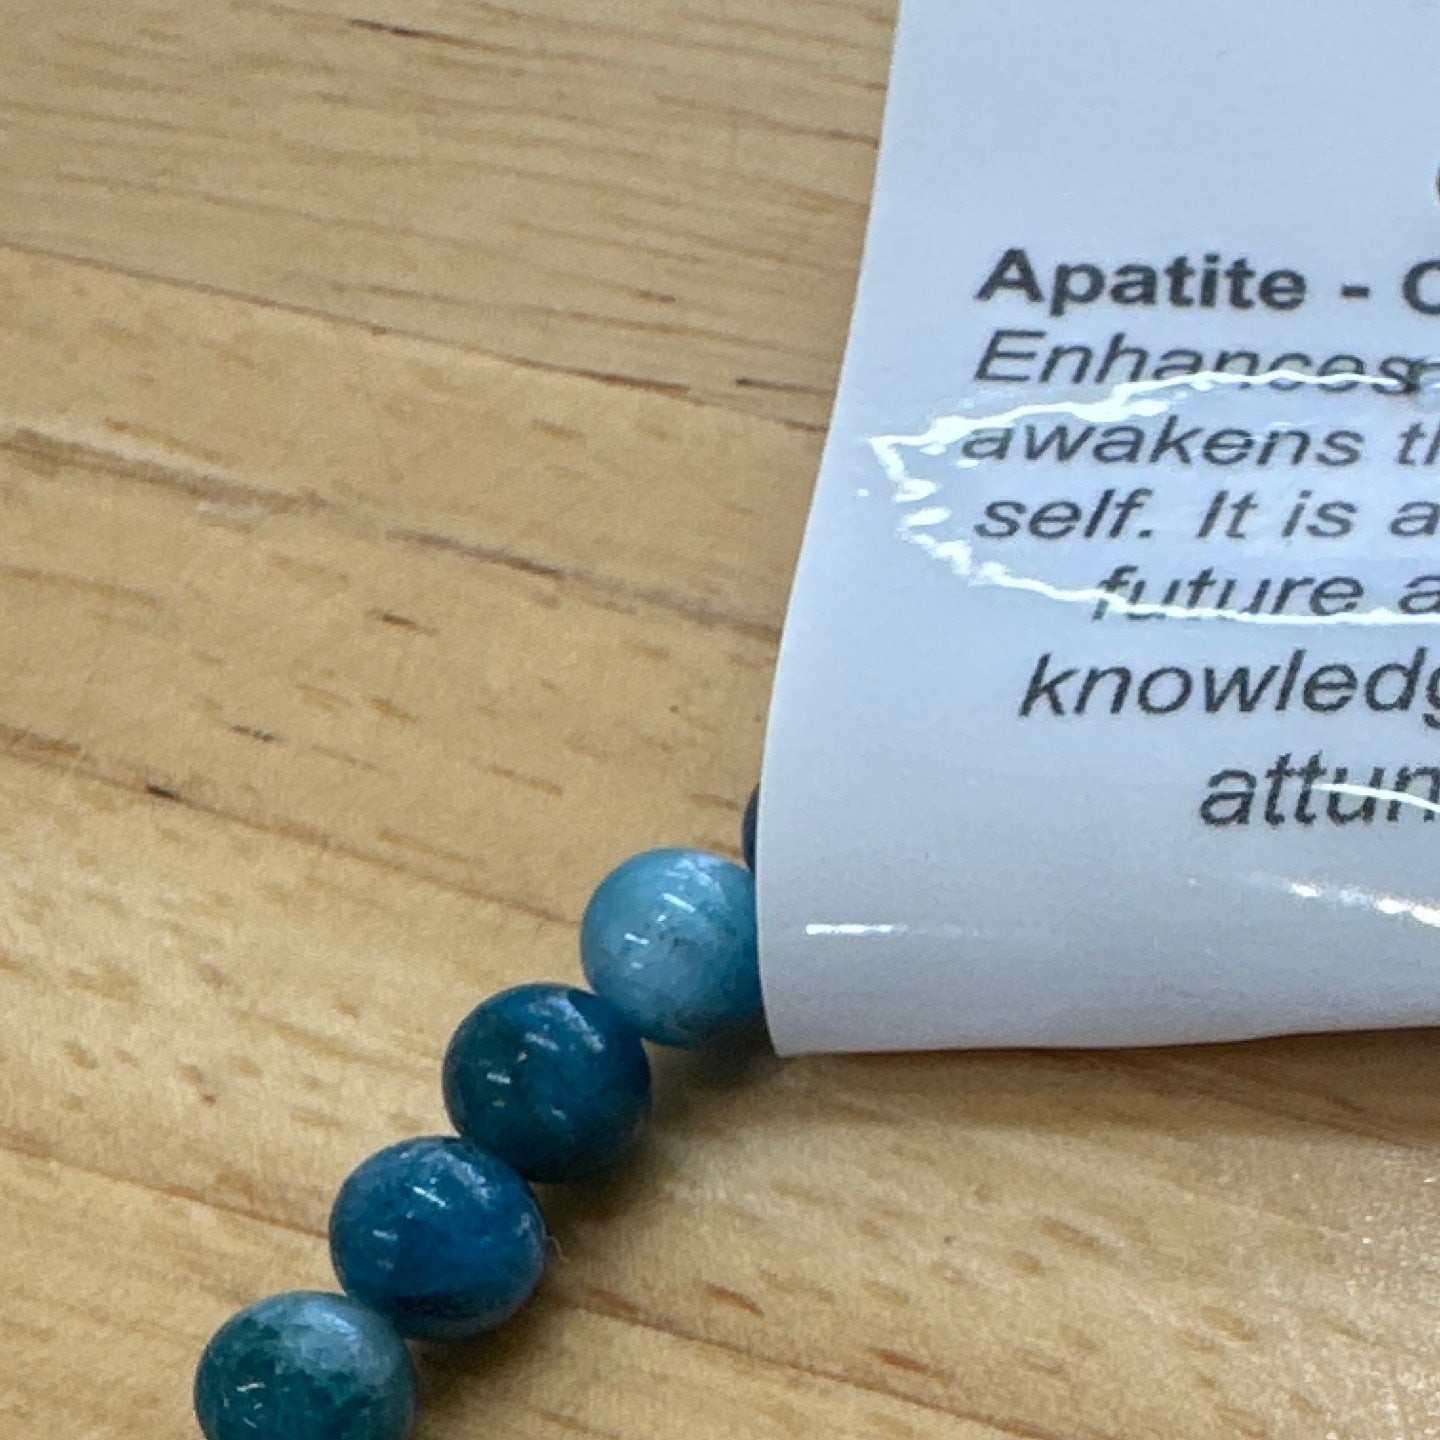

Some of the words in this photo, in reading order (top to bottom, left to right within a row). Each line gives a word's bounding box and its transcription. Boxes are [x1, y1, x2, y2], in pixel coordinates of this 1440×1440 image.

[976, 248, 1306, 317] Apatite
[973, 329, 1417, 396] Enhances
[961, 414, 1366, 467] awakens
[974, 488, 1154, 540] self.
[1197, 490, 1260, 540] It
[1281, 489, 1357, 539] is
[1091, 564, 1365, 620] future
